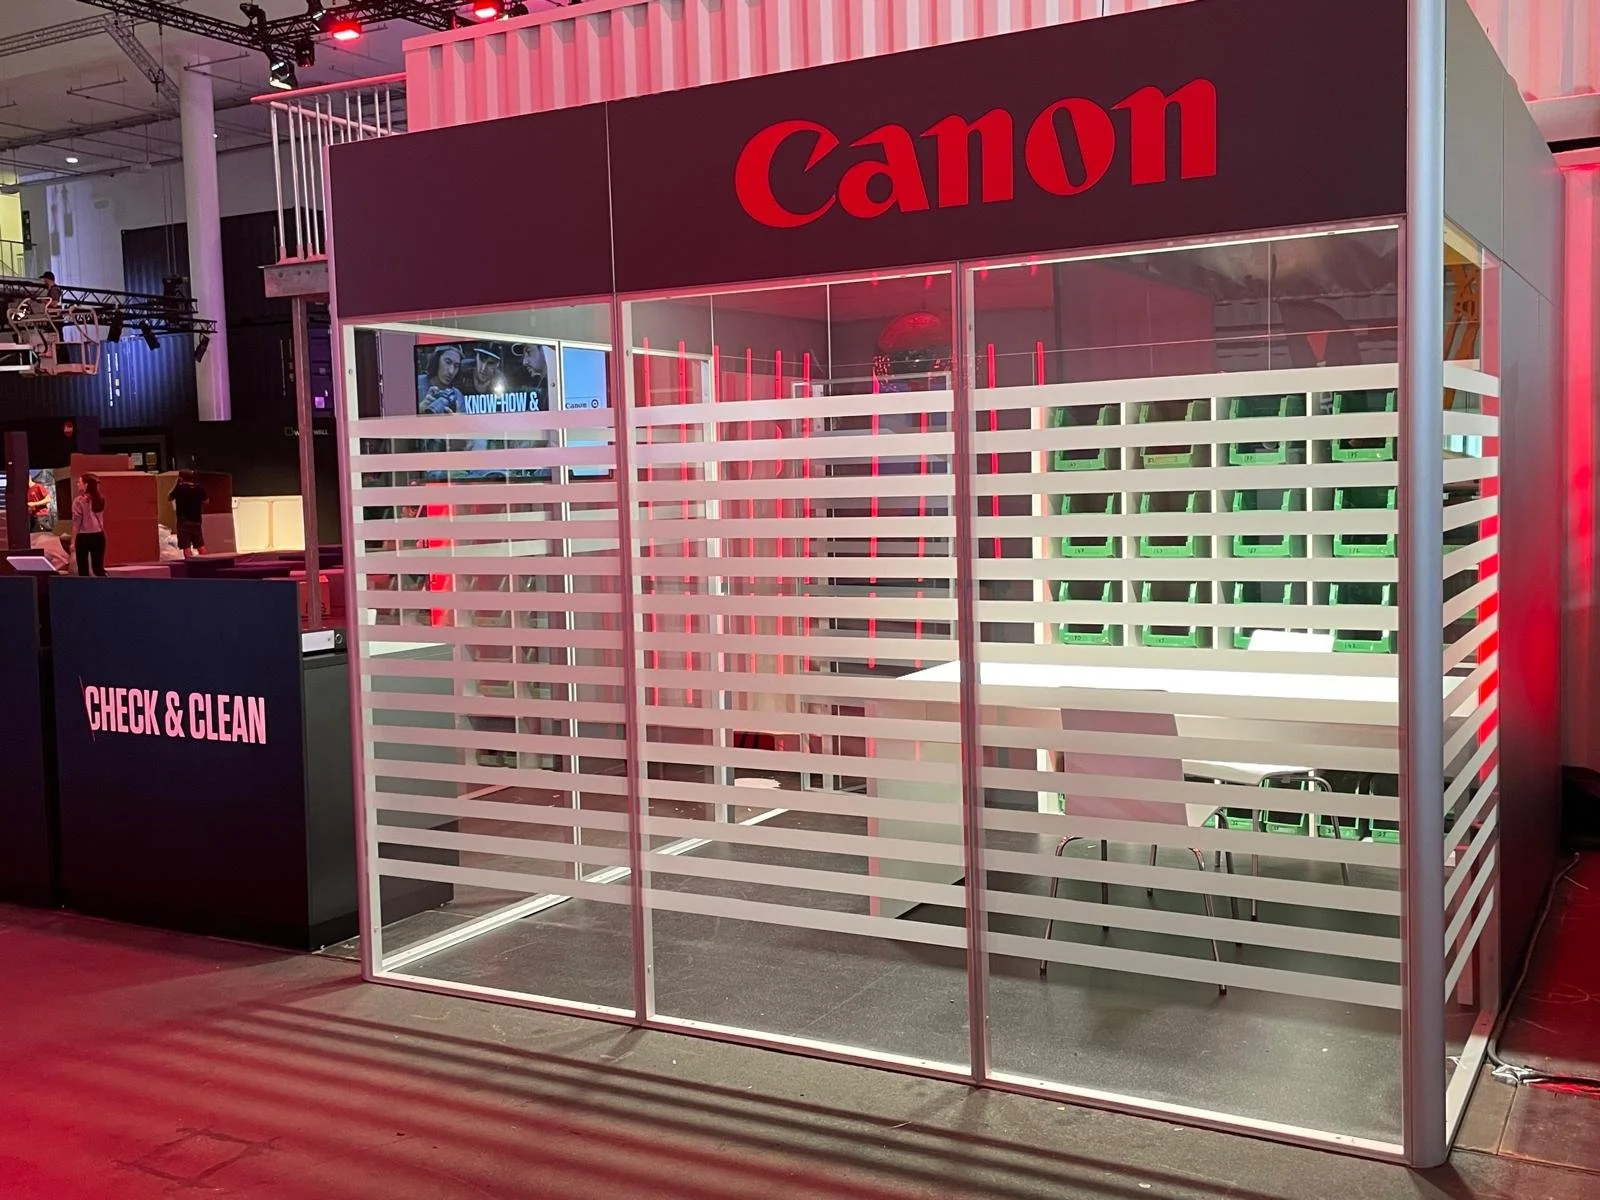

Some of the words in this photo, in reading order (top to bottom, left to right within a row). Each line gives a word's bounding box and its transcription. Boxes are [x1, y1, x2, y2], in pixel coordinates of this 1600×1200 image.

[735, 79, 1217, 228] Canon
[464, 392, 527, 414] KNOW-HOW
[529, 391, 539, 411] &
[85, 686, 160, 735] CHECK
[165, 690, 185, 738] &
[189, 692, 267, 744] CLEAN
